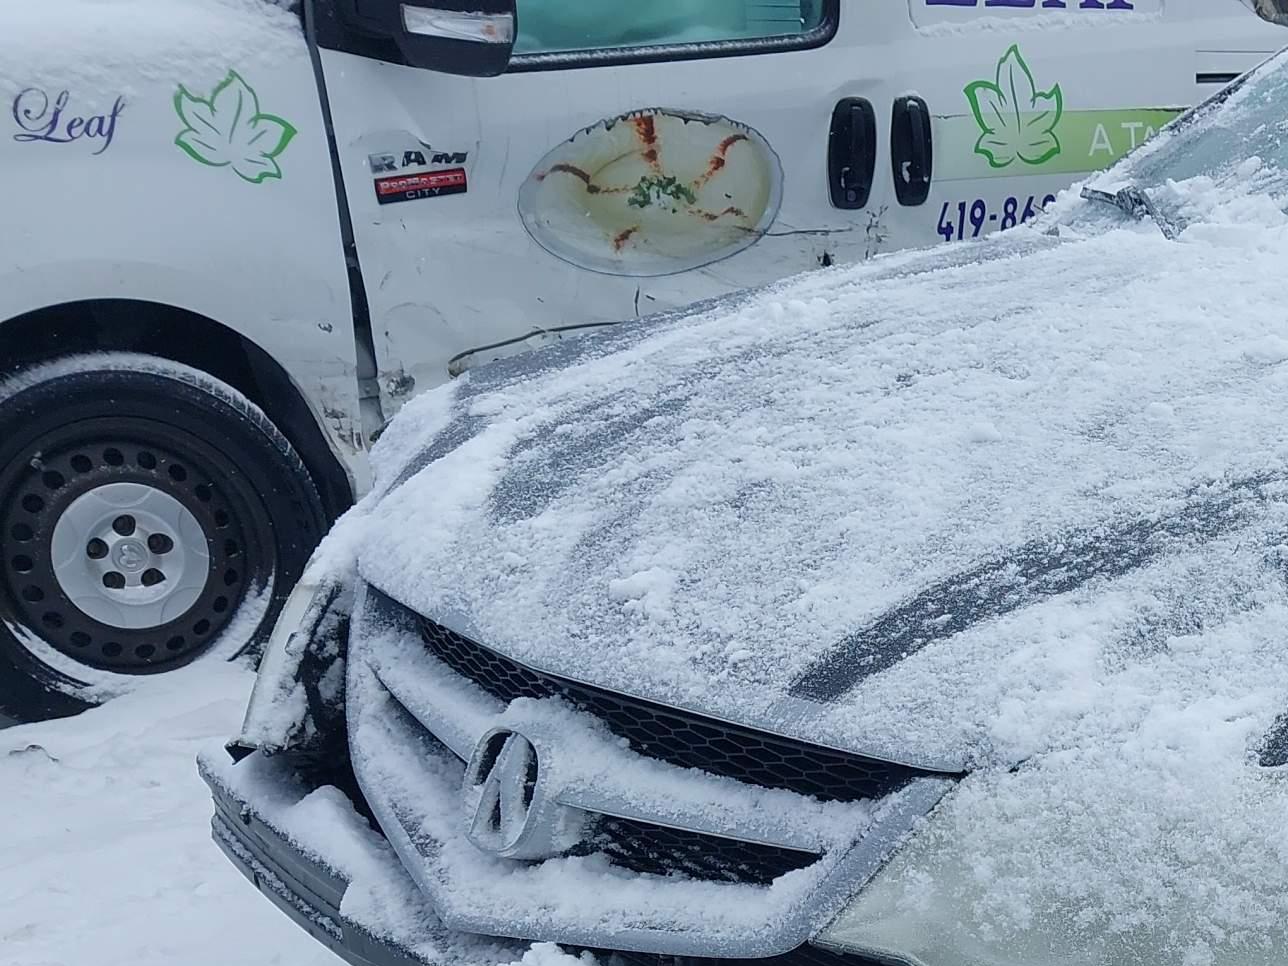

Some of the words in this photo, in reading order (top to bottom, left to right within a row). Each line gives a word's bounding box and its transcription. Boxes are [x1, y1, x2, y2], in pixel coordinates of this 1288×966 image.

[12, 87, 126, 155] Leaf
[1087, 123, 1114, 156] A
[368, 151, 468, 174] RAM
[406, 187, 440, 199] CITY
